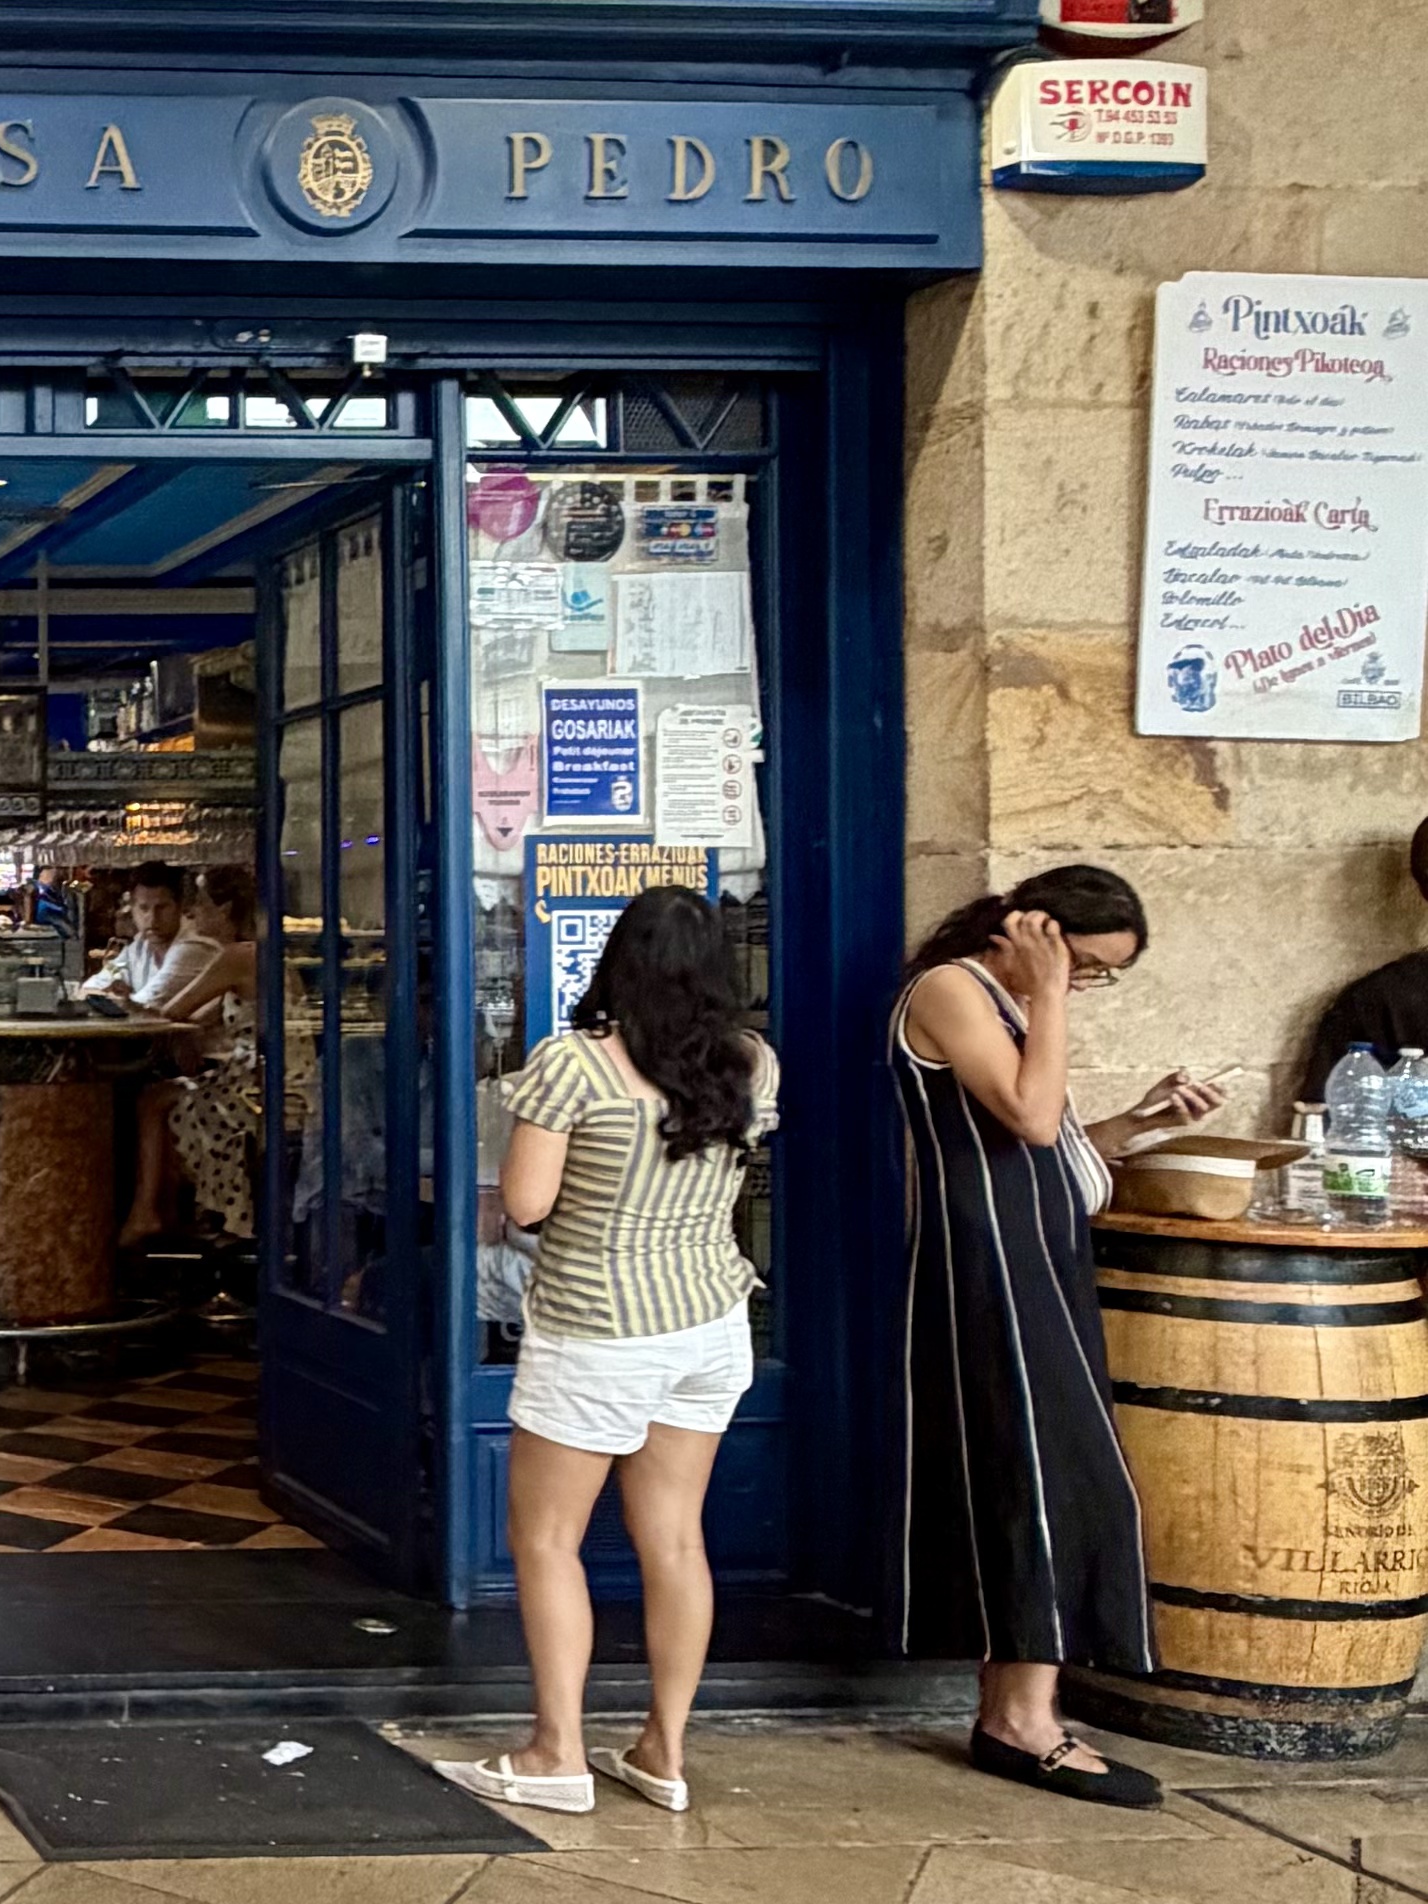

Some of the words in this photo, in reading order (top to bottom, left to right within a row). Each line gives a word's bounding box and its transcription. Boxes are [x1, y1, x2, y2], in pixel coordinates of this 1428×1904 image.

[504, 130, 878, 204] PEDRO
[1224, 640, 1294, 680] Plato
[550, 698, 636, 712] DESAYUNOS
[551, 718, 637, 741] GOSARIAK
[552, 760, 635, 772] Breakfast
[536, 864, 644, 897] PINTXOAK
